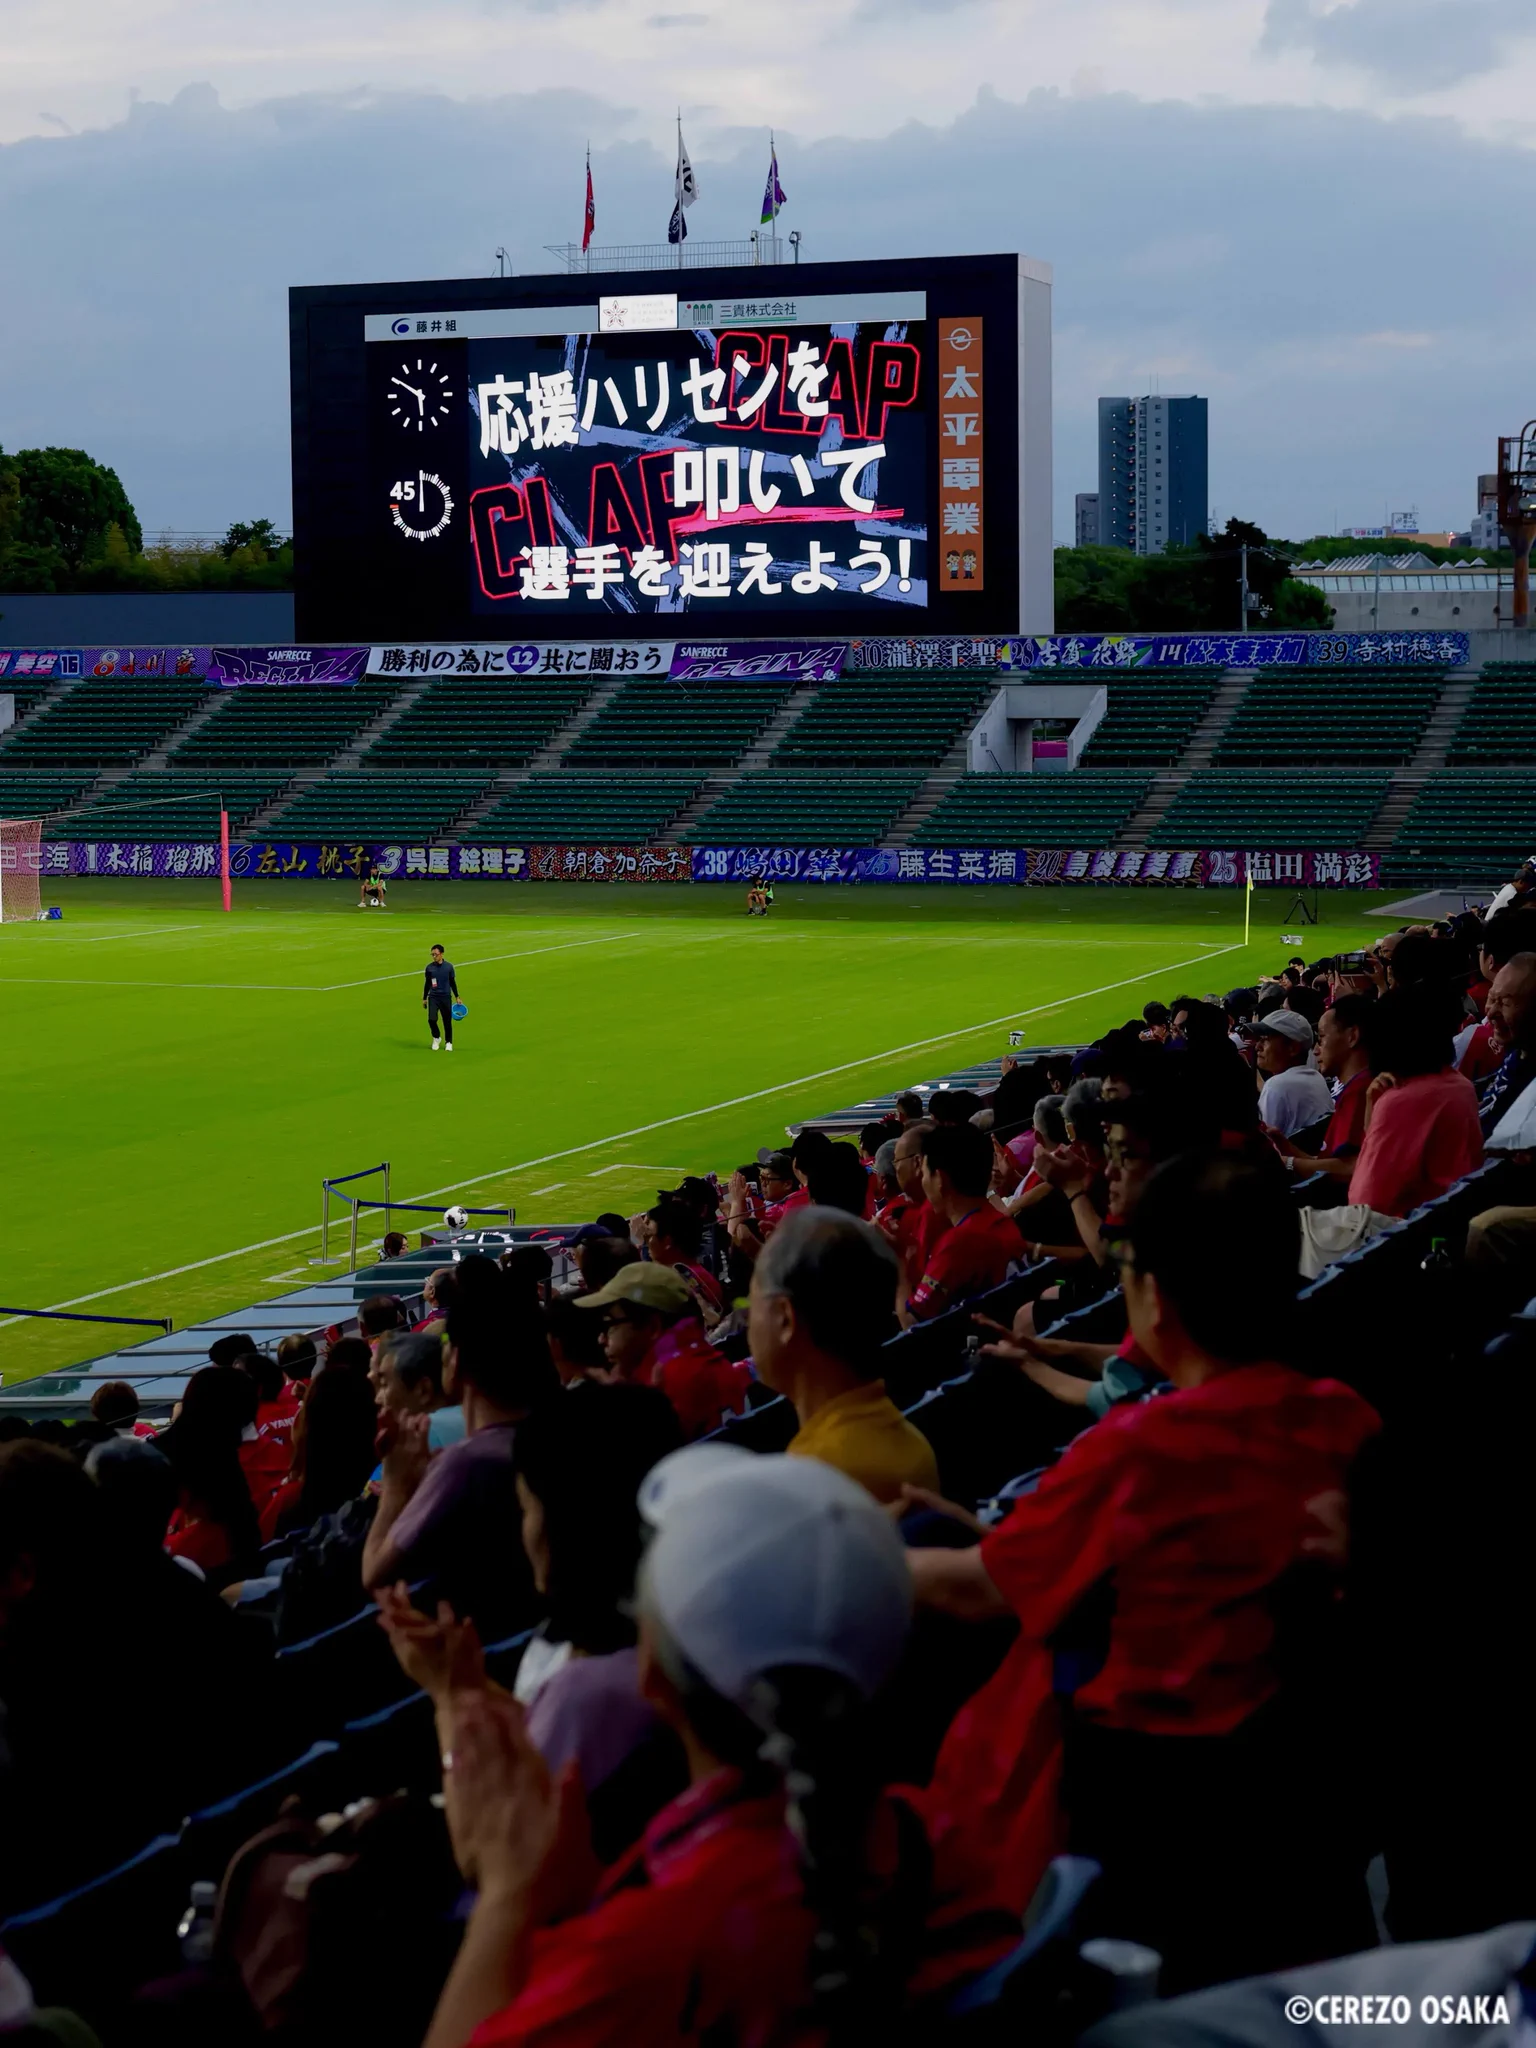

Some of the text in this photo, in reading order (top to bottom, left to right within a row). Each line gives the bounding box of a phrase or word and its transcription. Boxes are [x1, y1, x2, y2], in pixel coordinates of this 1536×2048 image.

[720, 302, 797, 317] 三貴株式会社
[416, 320, 457, 333] 藤井組
[478, 341, 830, 459] 応援ハリセンを
[943, 365, 980, 535] 太平電業
[389, 481, 415, 500] 45
[673, 443, 887, 521] 叩いて
[61, 654, 80, 675] 16
[93, 651, 119, 676] 8
[267, 650, 312, 661] SANFRECCE
[379, 648, 661, 673] 勝利の為に 12 共に闘おう
[672, 646, 846, 681] REGINA
[680, 647, 728, 658] SANFRECCE
[860, 644, 883, 668] 10
[1158, 645, 1182, 663] 14
[1316, 641, 1347, 662] 39
[213, 649, 369, 687] REGINA
[87, 843, 98, 871] 1
[229, 844, 253, 874] 6
[255, 844, 370, 875] 左山桃子
[377, 845, 403, 874] 3
[405, 847, 527, 874] 呉屋絵理子
[562, 850, 687, 875] 朝倉加奈子
[704, 850, 728, 875] 38
[864, 852, 893, 876] 15
[898, 850, 1016, 880] 藤生菜摘
[1030, 850, 1062, 879] 20
[1208, 850, 1238, 883] 25
[1244, 850, 1374, 884] 塩田満彩
